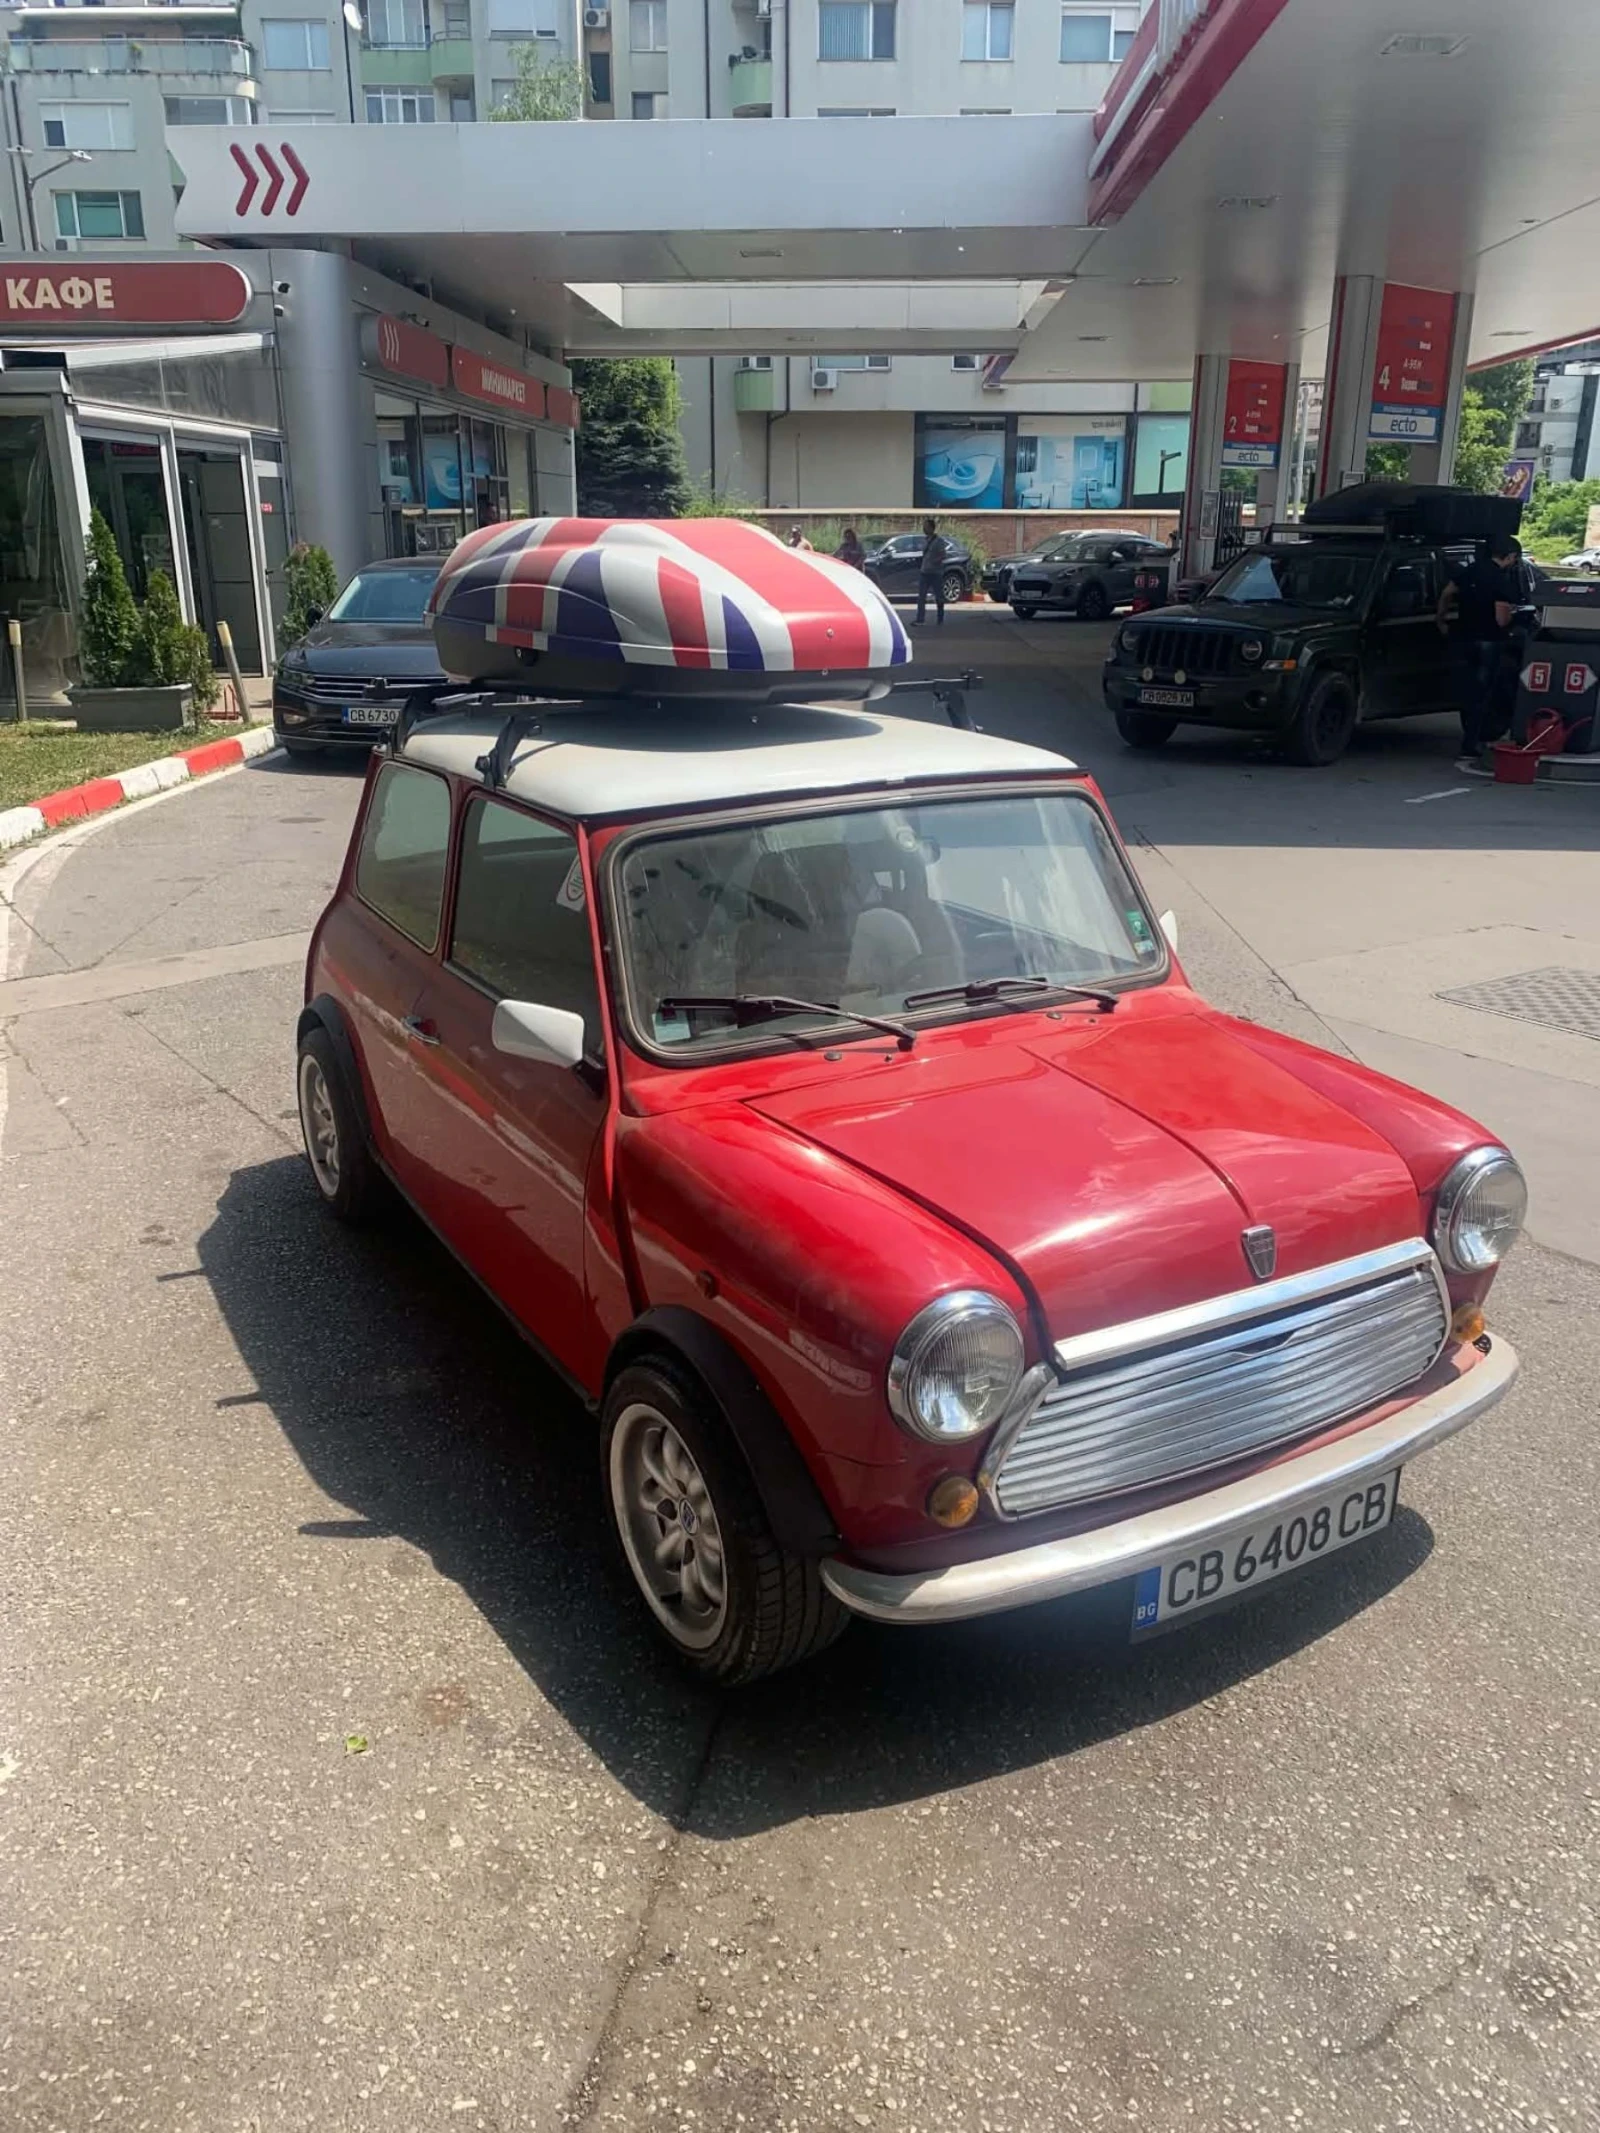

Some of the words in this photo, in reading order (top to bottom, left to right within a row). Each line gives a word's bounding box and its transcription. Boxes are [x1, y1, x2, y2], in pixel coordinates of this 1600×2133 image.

[6, 277, 115, 309] КАФЕ
[1379, 365, 1390, 391] 4
[1229, 416, 1237, 434] 2
[1390, 417, 1417, 432] ecto
[1238, 451, 1259, 462] ecto
[1535, 669, 1544, 685] 5
[1570, 671, 1582, 686] 6
[351, 709, 365, 721] CB
[368, 710, 396, 722] 6730
[1168, 1550, 1224, 1609] CB
[1234, 1506, 1330, 1583] 6408
[1338, 1482, 1387, 1539] CB
[1136, 1602, 1156, 1621] BG
